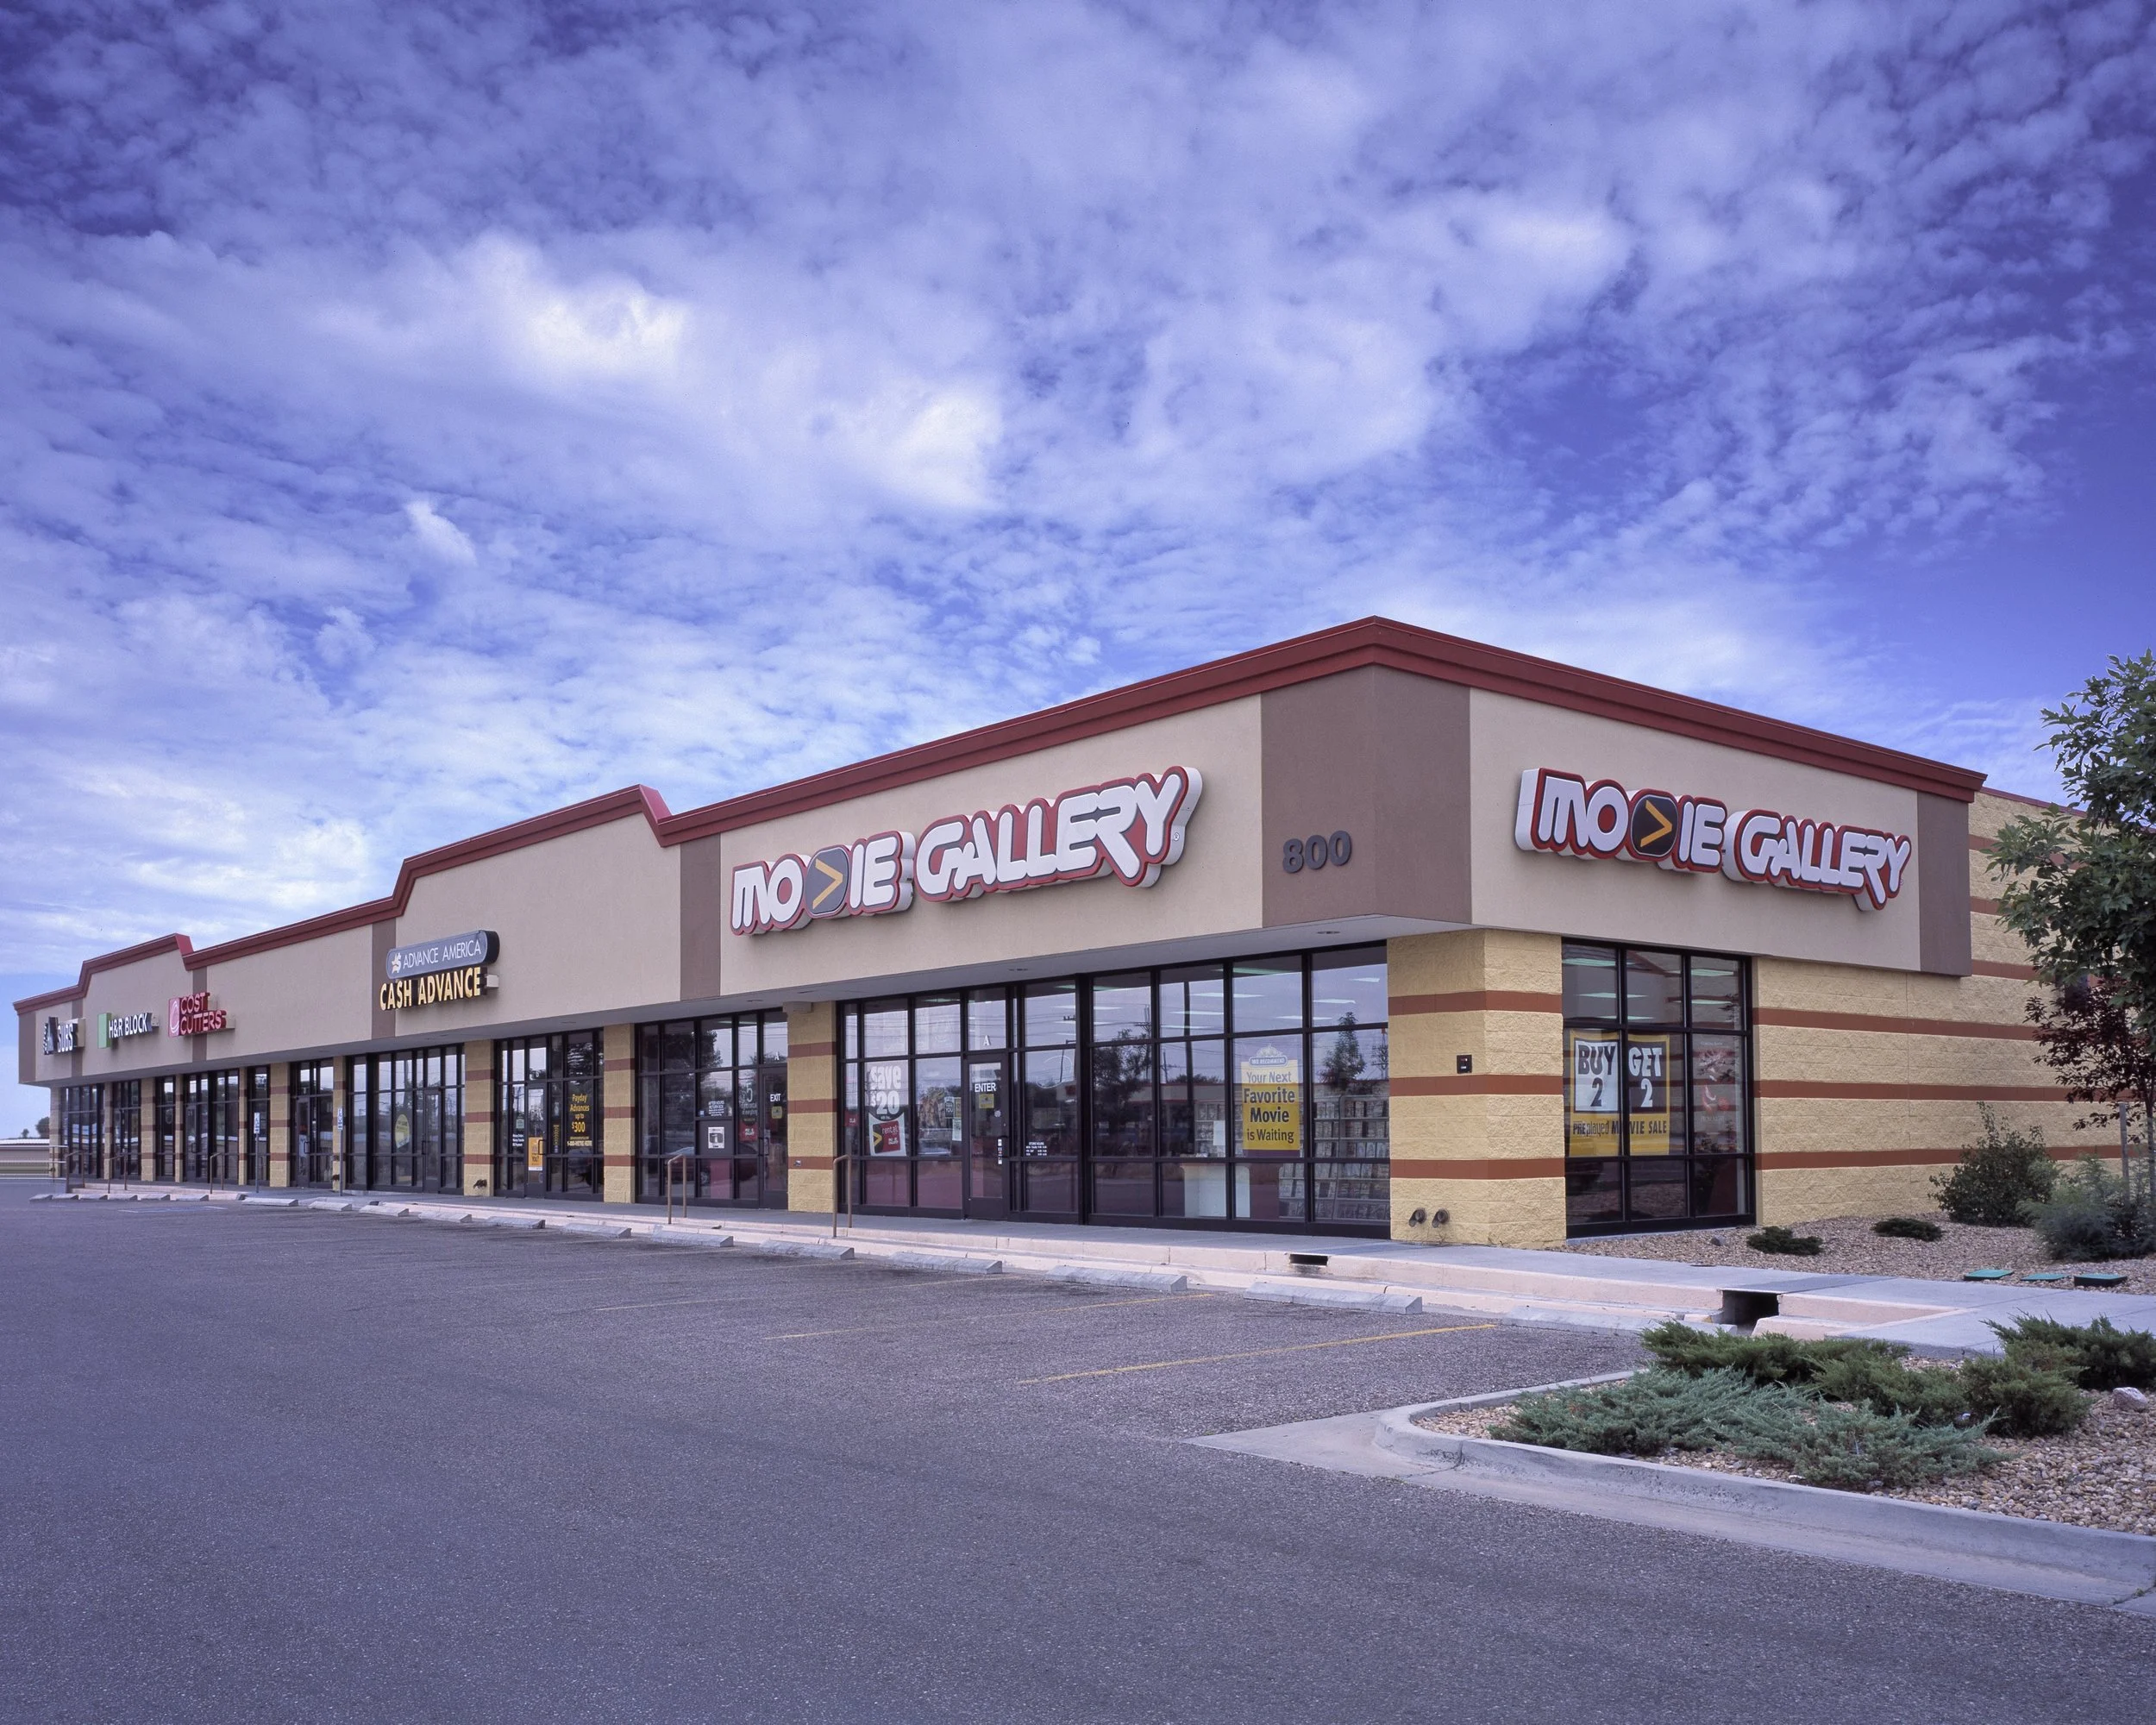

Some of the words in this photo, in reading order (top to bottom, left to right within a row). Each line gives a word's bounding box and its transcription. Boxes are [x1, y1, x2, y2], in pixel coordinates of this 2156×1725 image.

[918, 773, 1182, 895] GALLERY
[1282, 830, 1351, 874] 800
[1739, 815, 1911, 905] GALLERY
[403, 947, 439, 969] ADVANCE
[442, 939, 482, 962] AMERICA
[379, 980, 412, 1011] CASH
[417, 967, 481, 1006] ADVANCE
[180, 992, 206, 1016] COST
[109, 1017, 123, 1039] H&R
[124, 1012, 148, 1037] BLOCK
[179, 1010, 222, 1035] CUTTERS
[983, 1035, 991, 1046] A
[1577, 1044, 1616, 1076] BUY
[1628, 1046, 1663, 1077] GET
[869, 1064, 902, 1090] save
[975, 1082, 997, 1093] ENTER
[1246, 1072, 1267, 1083] Your
[1269, 1071, 1292, 1083] Next
[572, 1093, 587, 1103] Payday
[769, 1093, 781, 1102] EXIT
[870, 1089, 900, 1115] $20
[1244, 1087, 1295, 1104] Favorite
[1589, 1076, 1603, 1107] 2
[1640, 1077, 1653, 1108] 2
[572, 1121, 586, 1132] $300
[1250, 1107, 1290, 1123] Movie
[1611, 1120, 1645, 1135] MVIE
[1648, 1120, 1667, 1134] SALE
[1247, 1128, 1255, 1140] is
[1256, 1128, 1294, 1144] Waiting
